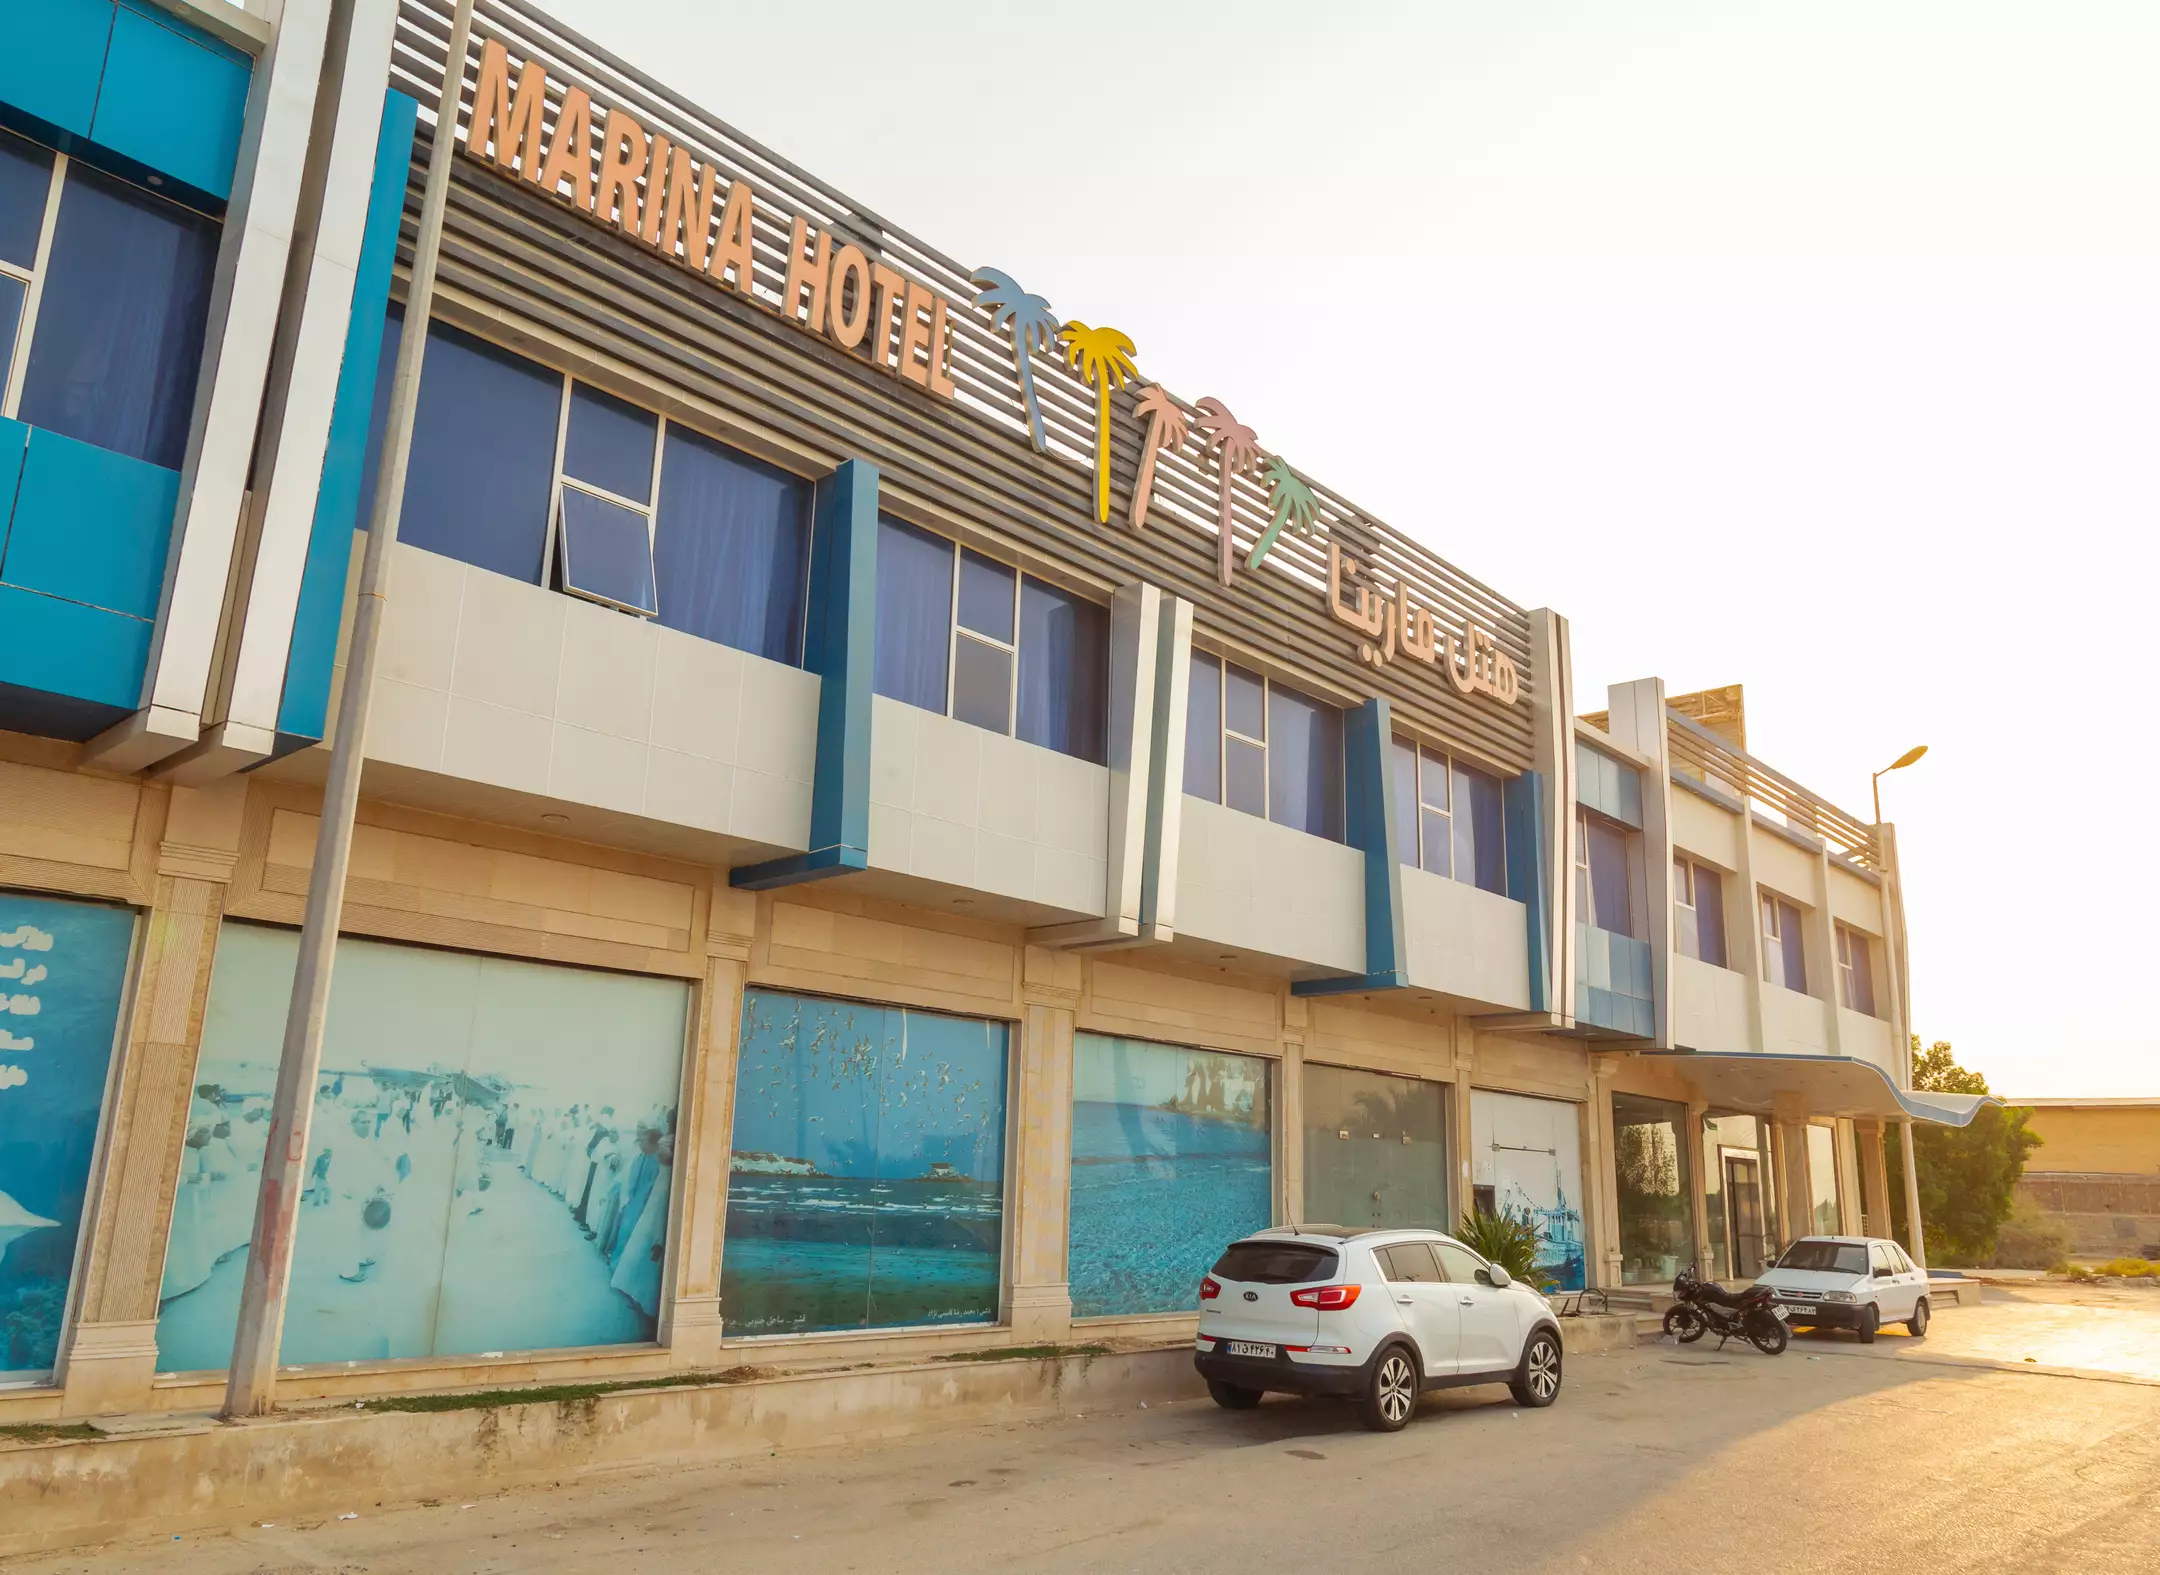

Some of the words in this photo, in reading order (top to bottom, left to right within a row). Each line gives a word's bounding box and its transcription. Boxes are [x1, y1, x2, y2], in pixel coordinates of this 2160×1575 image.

[464, 37, 754, 300] MARINA
[780, 215, 955, 400] HOTEL
[1325, 541, 1435, 668] مارینا
[1443, 619, 1518, 705] هتل
